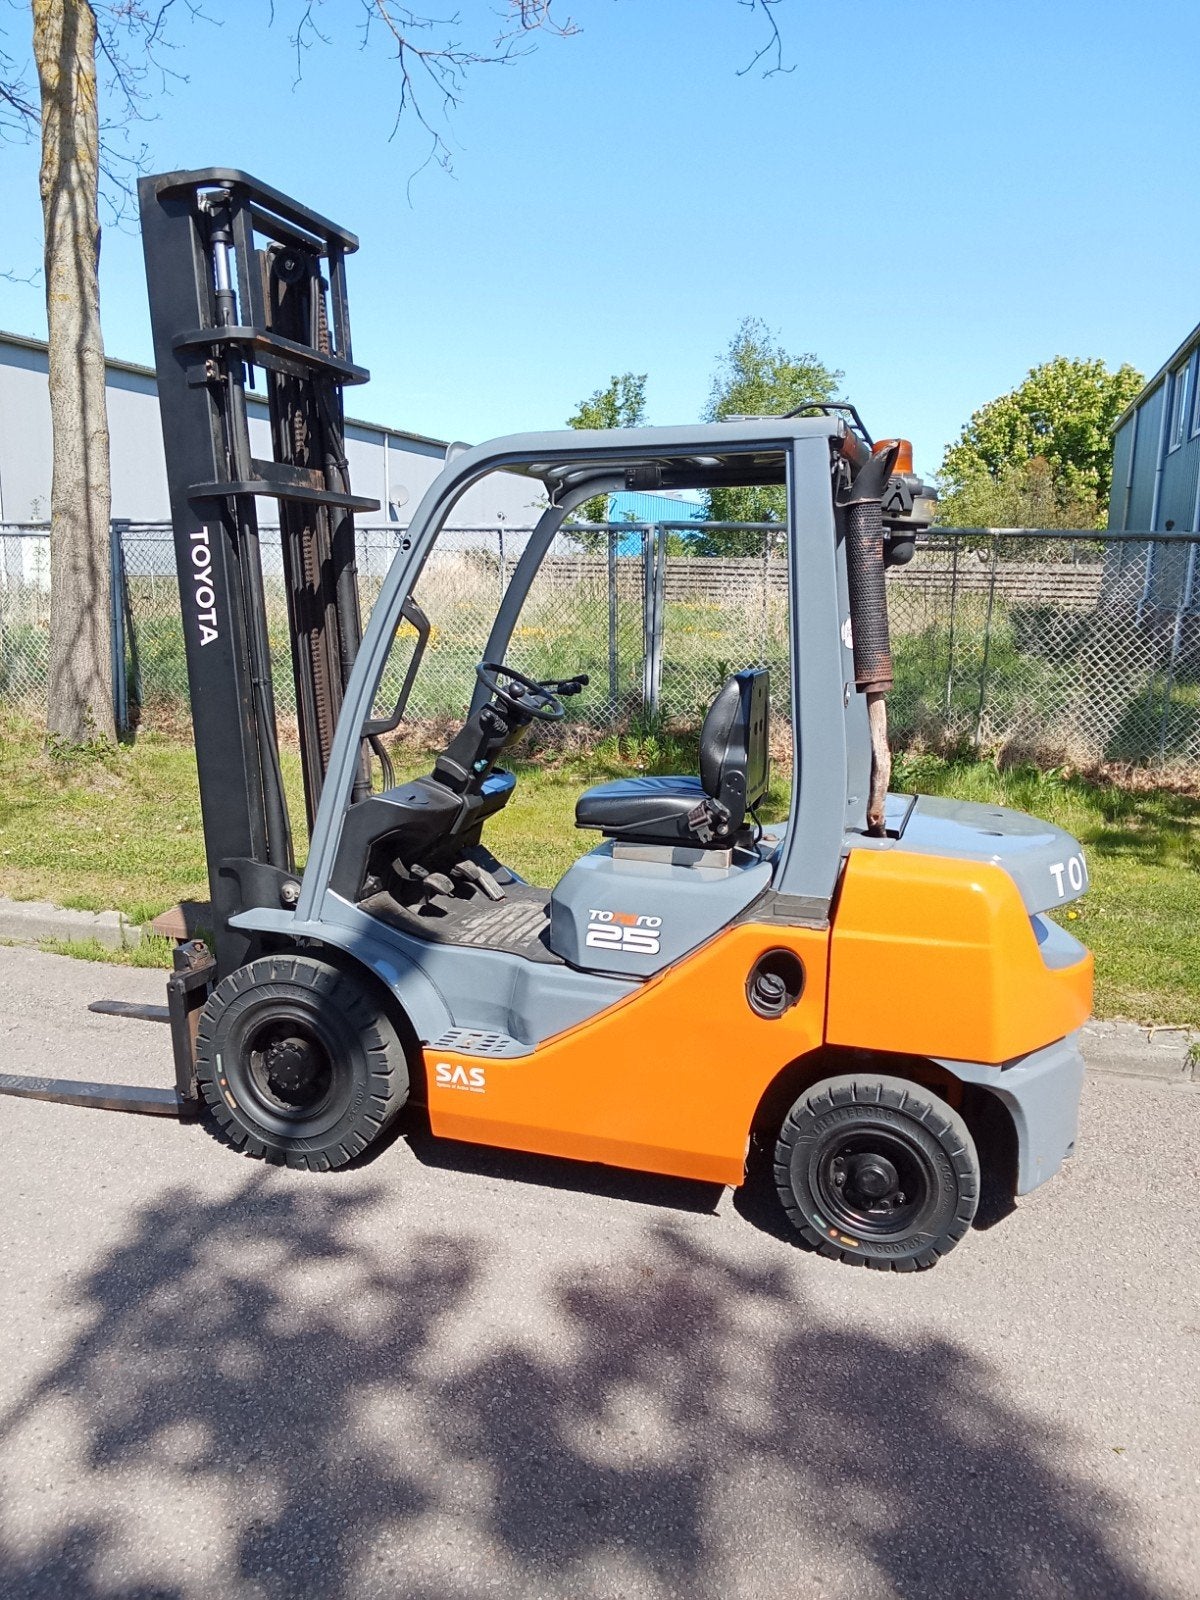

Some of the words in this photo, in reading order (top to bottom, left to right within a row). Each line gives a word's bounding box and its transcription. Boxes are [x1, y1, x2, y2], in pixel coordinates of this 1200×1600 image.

[190, 526, 218, 646] TOYOTA
[586, 923, 660, 955] 25
[436, 1063, 485, 1086] SAS
